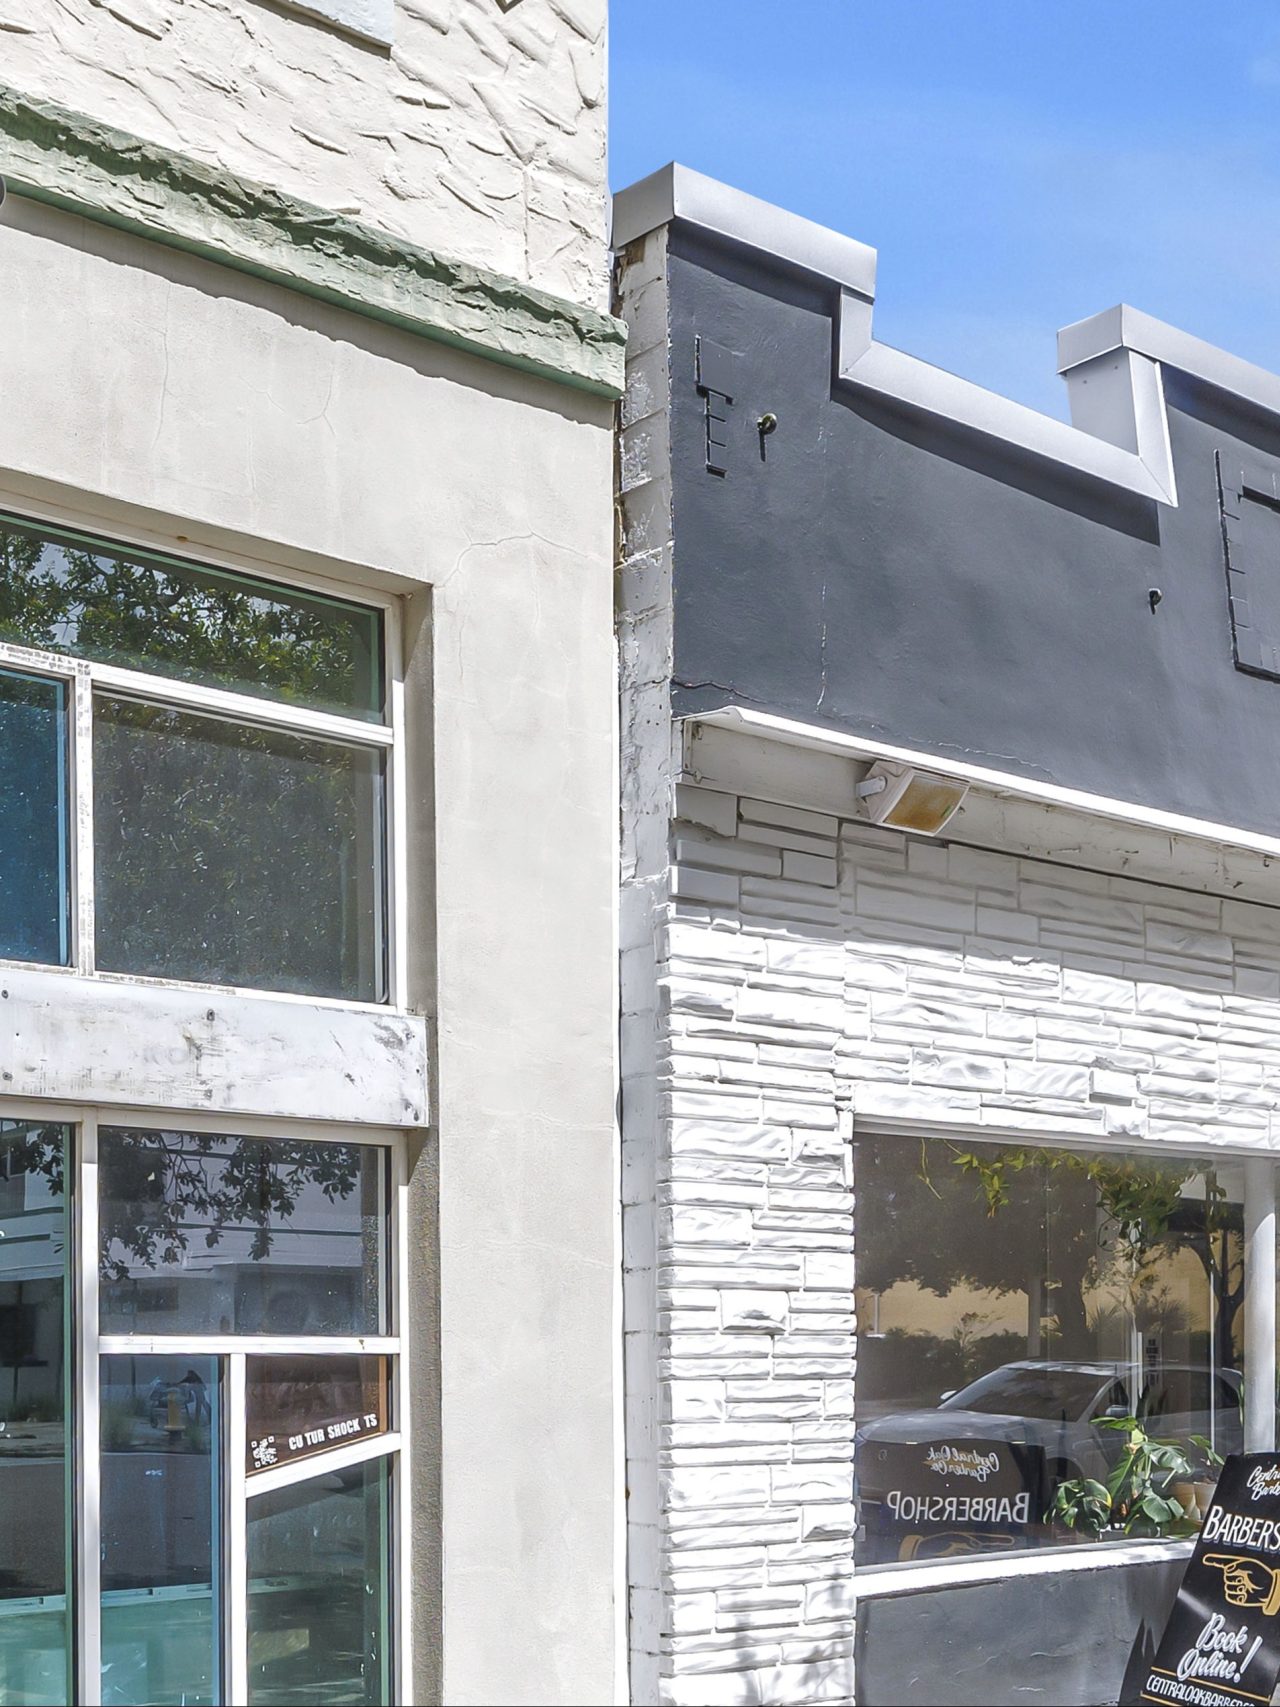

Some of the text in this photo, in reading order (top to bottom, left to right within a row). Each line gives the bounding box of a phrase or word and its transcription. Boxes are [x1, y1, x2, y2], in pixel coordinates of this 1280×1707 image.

[327, 1418, 361, 1440] SHOCK
[363, 1413, 378, 1428] TS
[1195, 1612, 1249, 1653] Book
[1177, 1635, 1263, 1684] Online!
